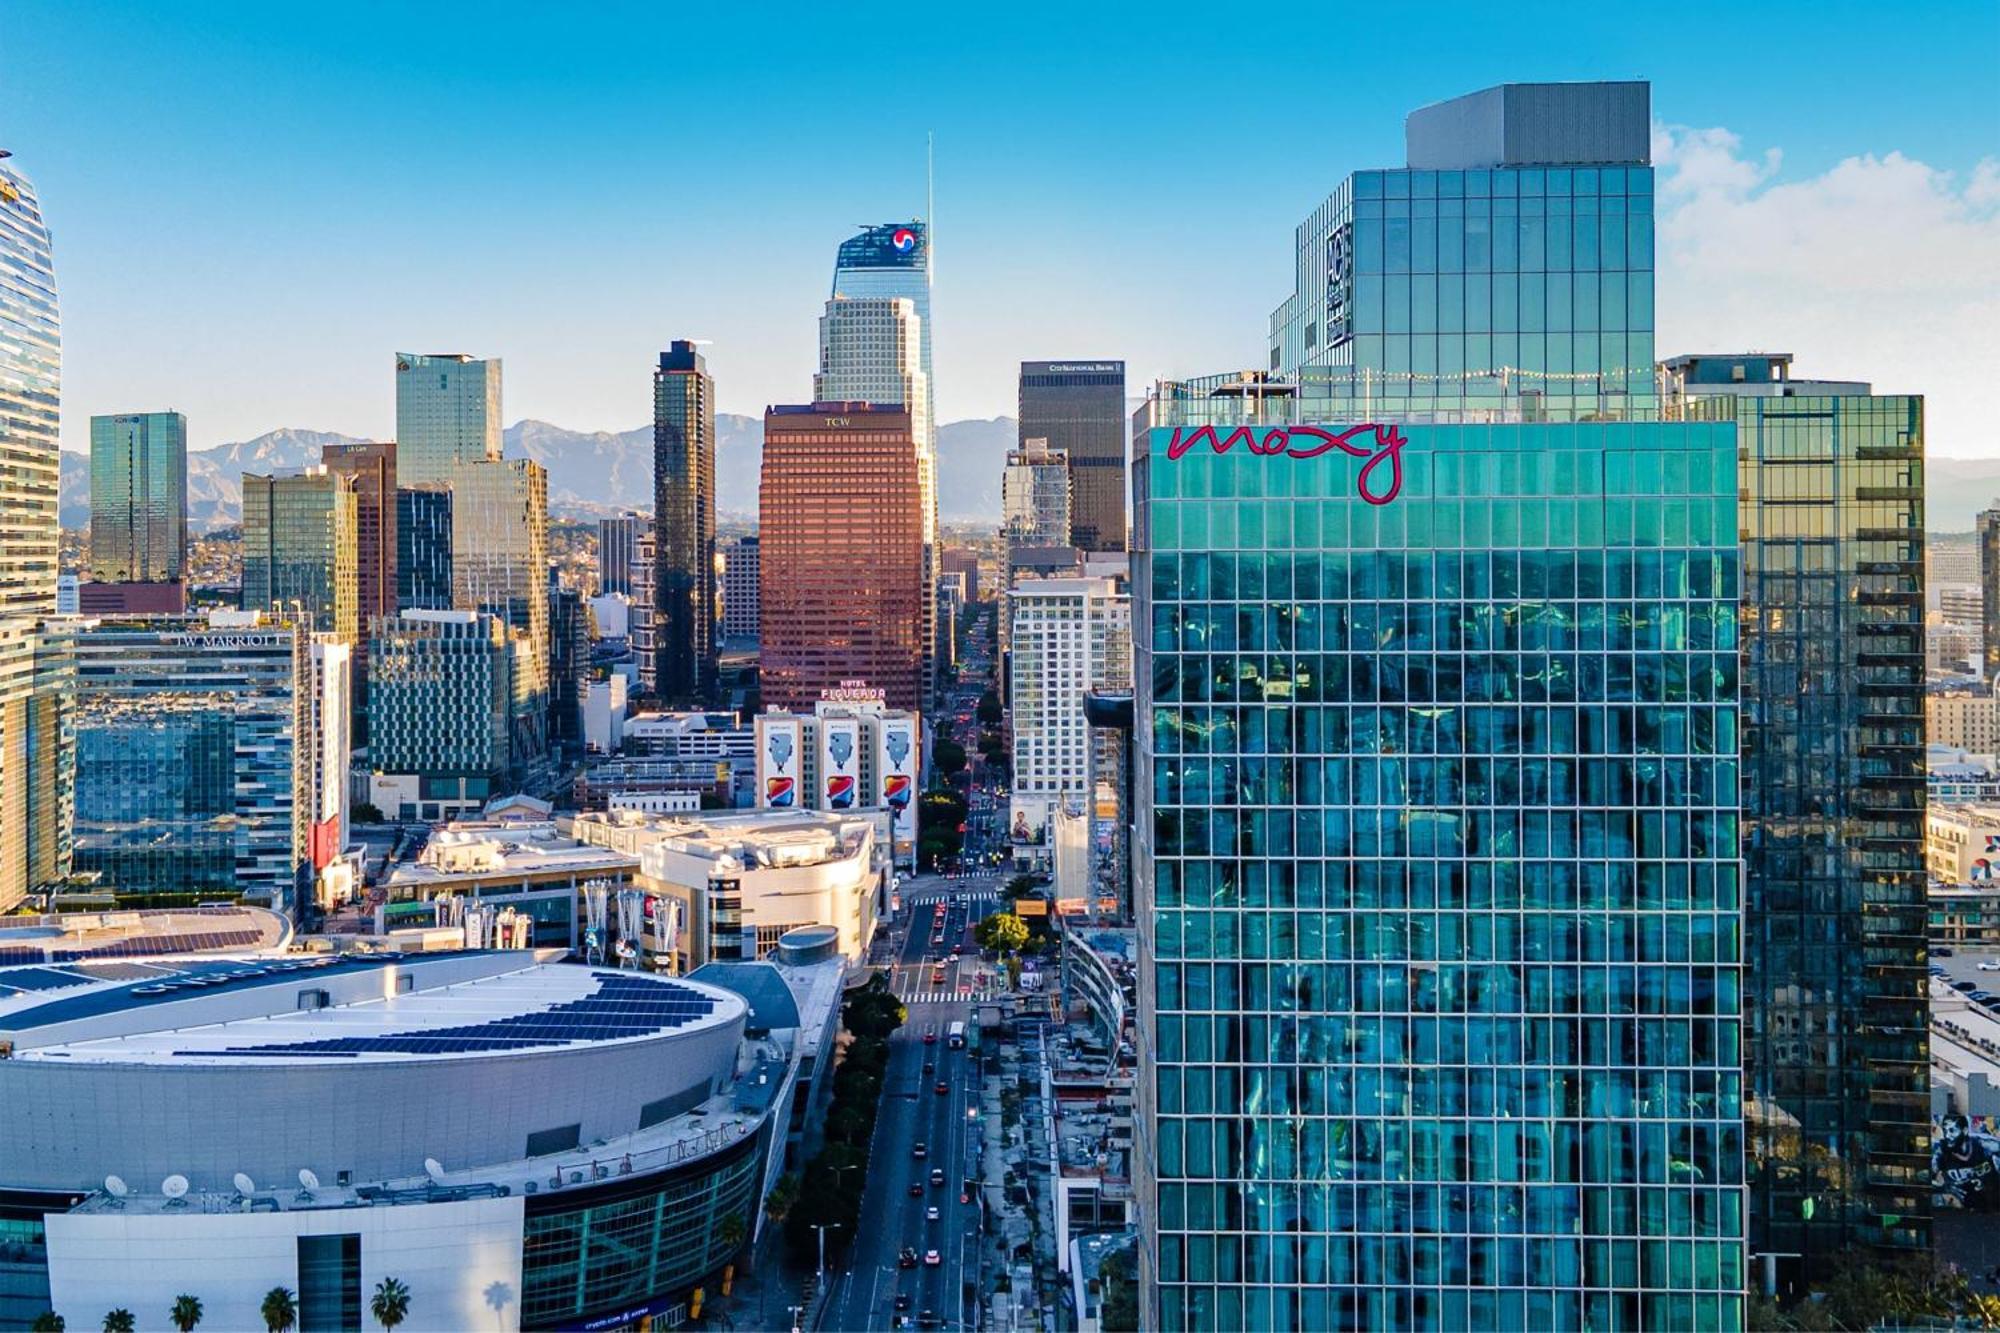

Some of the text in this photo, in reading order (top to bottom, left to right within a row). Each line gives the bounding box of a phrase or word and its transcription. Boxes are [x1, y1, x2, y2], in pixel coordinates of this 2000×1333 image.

[825, 416, 851, 427] TCW
[1168, 423, 1408, 504] moxy
[177, 635, 280, 648] JW MARRIOTT
[840, 680, 866, 688] HOTEL
